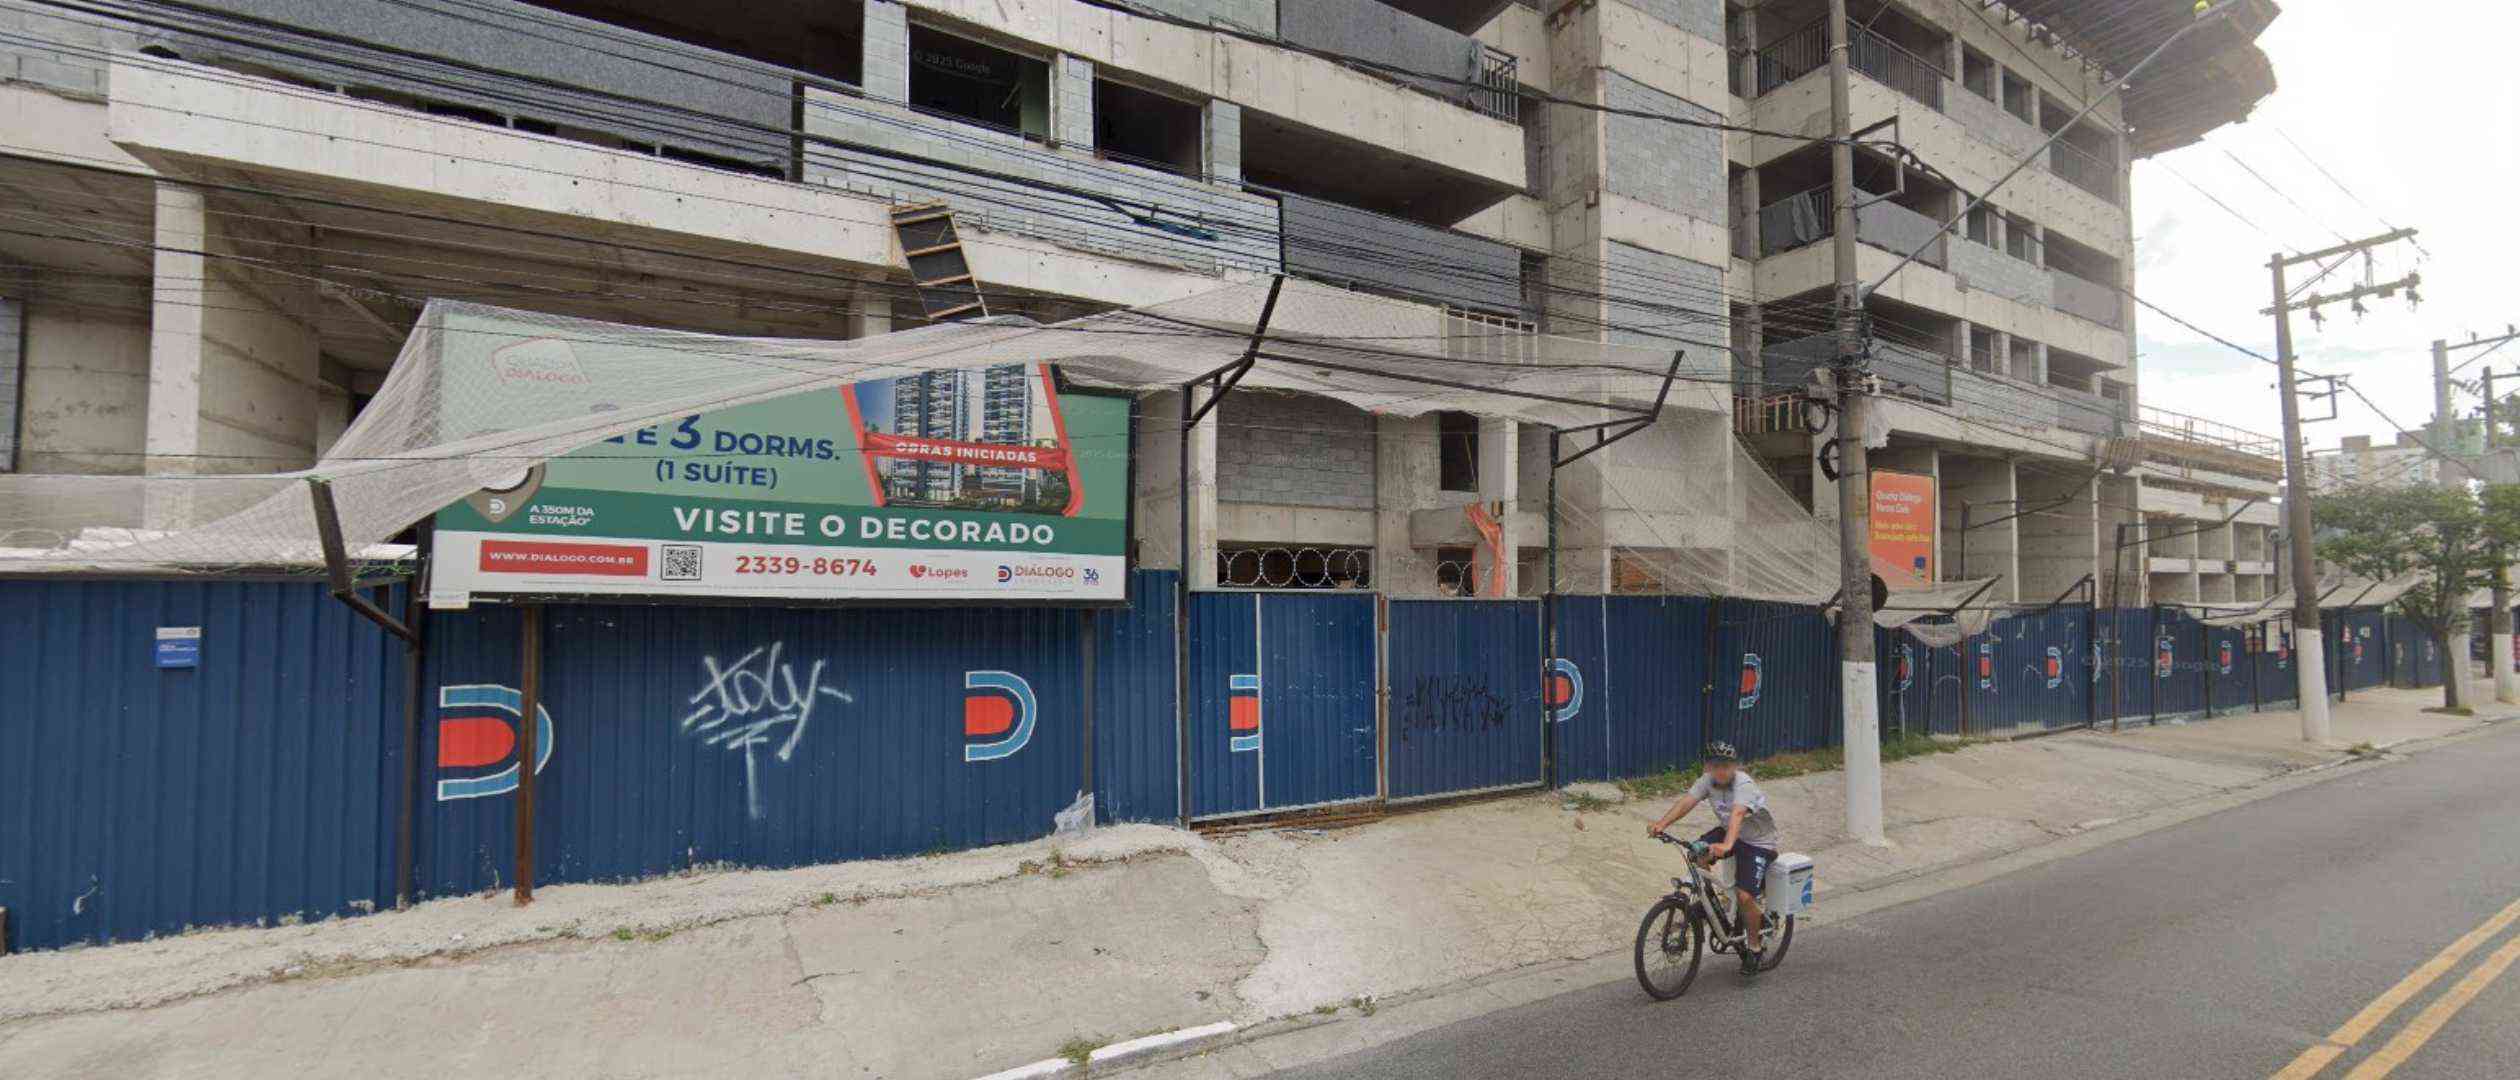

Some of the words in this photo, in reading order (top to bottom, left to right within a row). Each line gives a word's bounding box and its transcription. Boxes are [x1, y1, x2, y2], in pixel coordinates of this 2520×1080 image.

[669, 414, 702, 449] 3
[714, 430, 840, 460] DORMS.
[895, 442, 952, 457] OBRAS
[957, 443, 1037, 463] INICIADAS
[656, 459, 675, 482] (1
[684, 460, 778, 490] SUÍTE)
[529, 504, 540, 514] A
[577, 506, 595, 517] DA
[672, 507, 805, 536] VISITE
[819, 514, 846, 537] O
[860, 516, 1055, 545] DECORADO
[489, 551, 634, 565] WWW.DIALOGO.COM.BR
[735, 556, 877, 576] 2339-8674
[928, 565, 968, 579] Lopes
[1015, 563, 1074, 578] DIÁLOGO
[1083, 568, 1099, 580] 36
